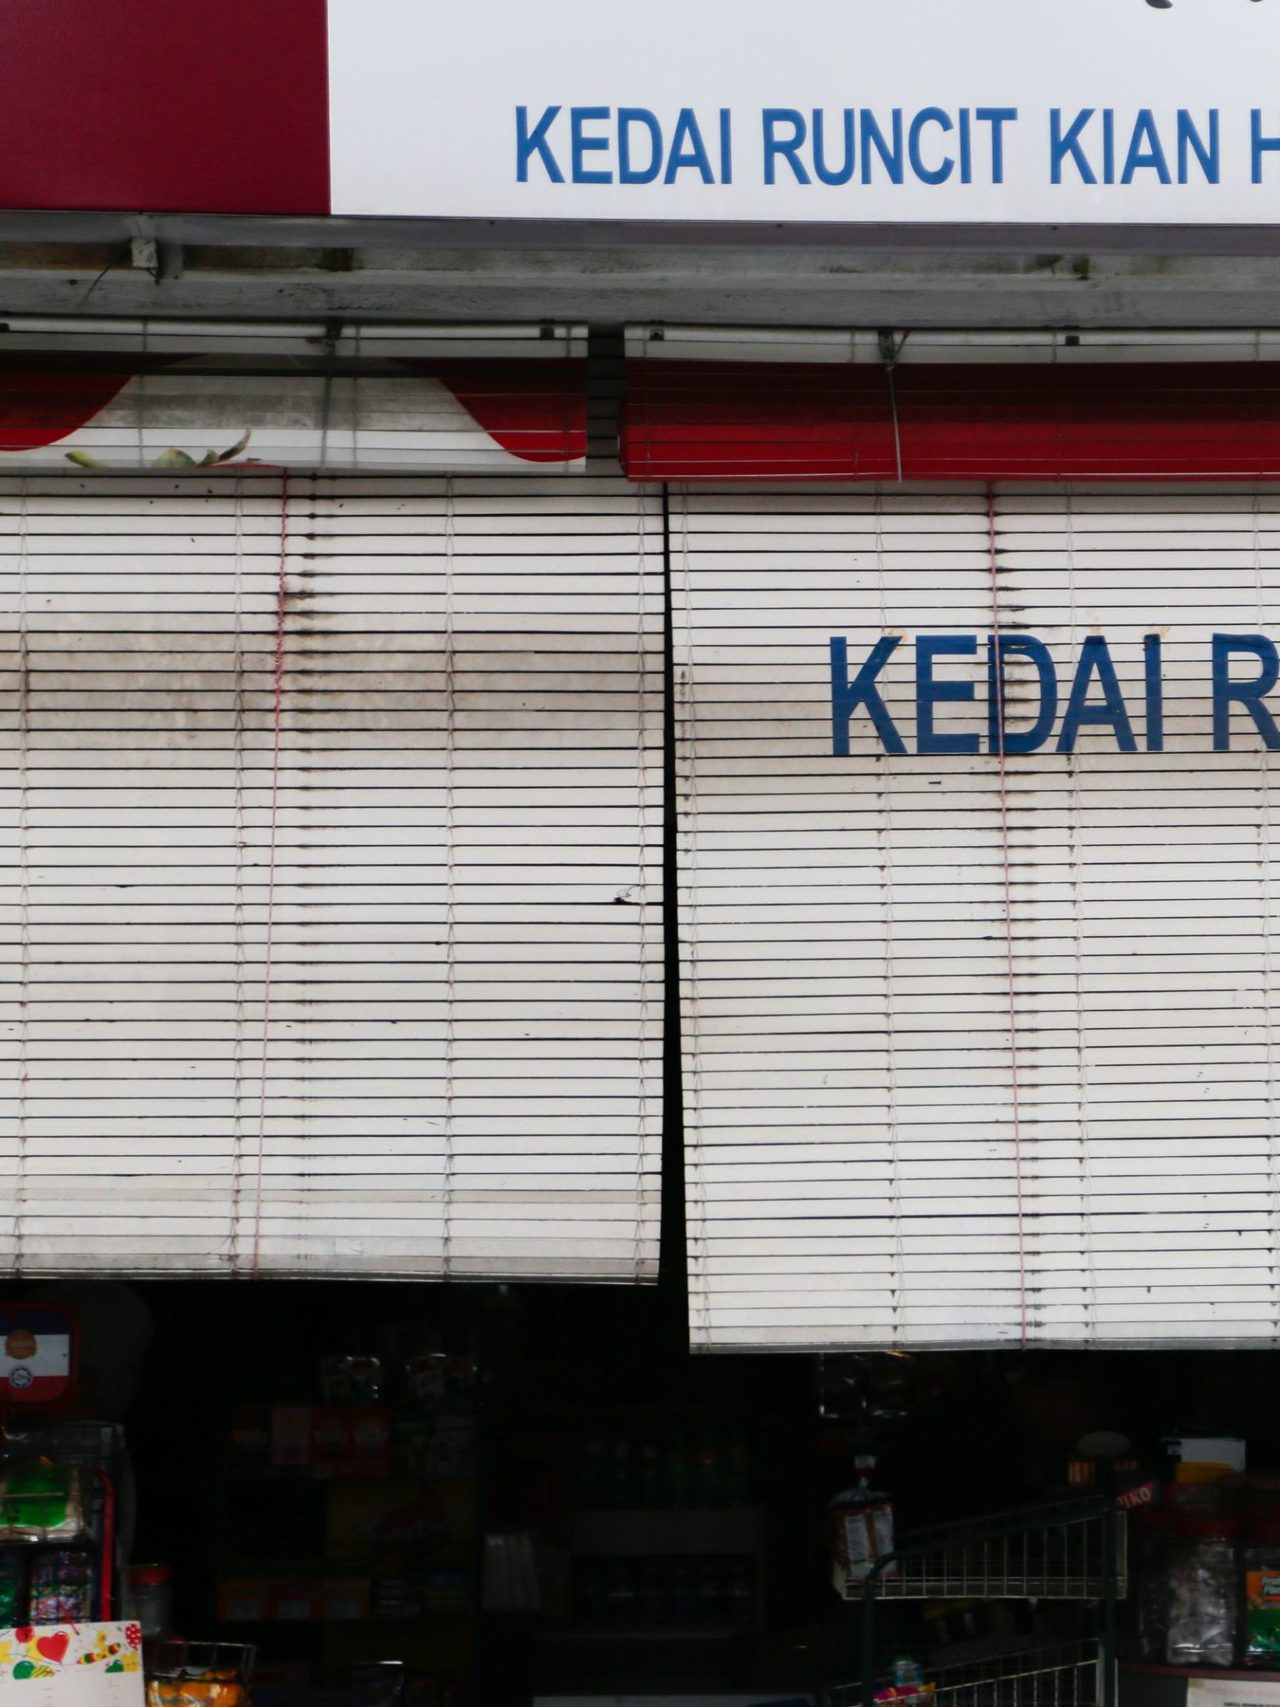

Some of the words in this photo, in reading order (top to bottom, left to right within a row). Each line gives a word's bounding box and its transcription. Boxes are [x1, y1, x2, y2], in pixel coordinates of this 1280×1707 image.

[514, 103, 733, 186] KEDAI
[760, 105, 1019, 187] RUNCIT
[1048, 106, 1221, 186] KIAN
[829, 634, 1162, 755] KEDAI
